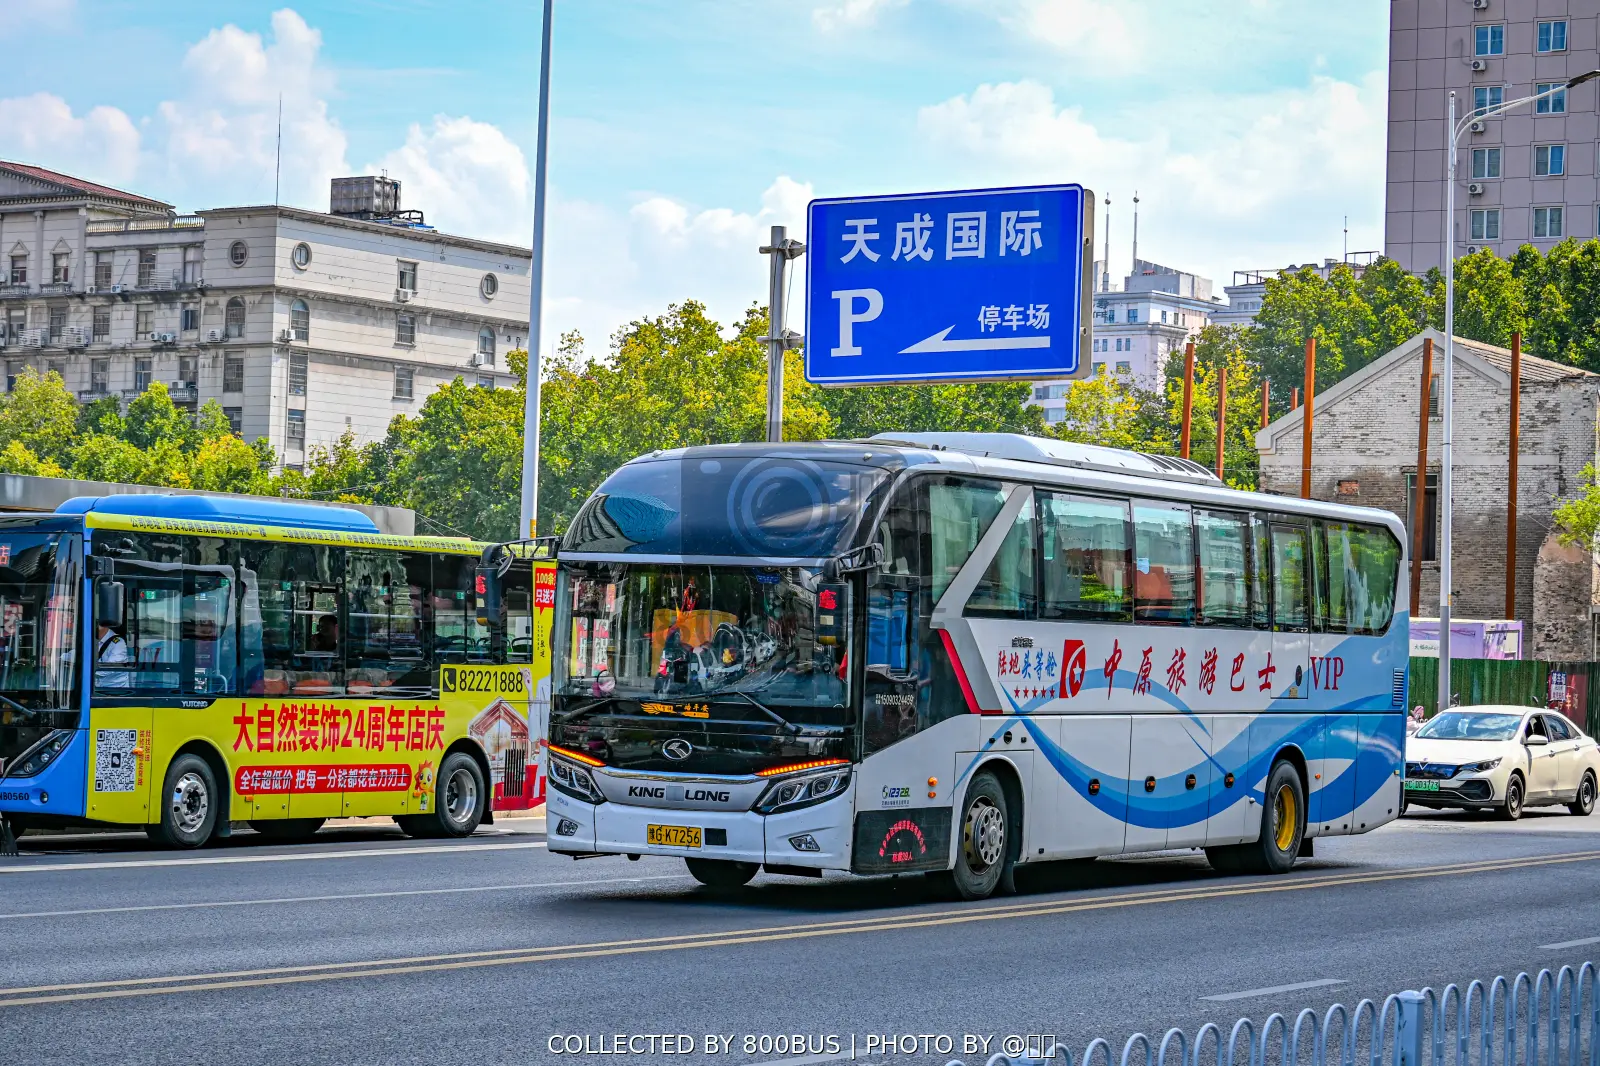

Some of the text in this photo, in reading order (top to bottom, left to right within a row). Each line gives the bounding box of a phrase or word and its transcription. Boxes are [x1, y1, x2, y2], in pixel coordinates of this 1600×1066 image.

[840, 209, 1044, 265] 天成国际
[830, 288, 884, 358] P
[977, 303, 1051, 333] 停车场
[997, 648, 1058, 681] 陆地头等舱
[1103, 638, 1276, 700] 中原旅游巴士
[1309, 656, 1344, 691] VIP
[459, 671, 523, 693] 82221888
[181, 700, 209, 708] YUTONG
[232, 702, 446, 753] 大自然装饰24周年店庆
[239, 767, 408, 791] 全年超低价 把每一分钱都花在刀刃上
[629, 786, 731, 802] KING LONG
